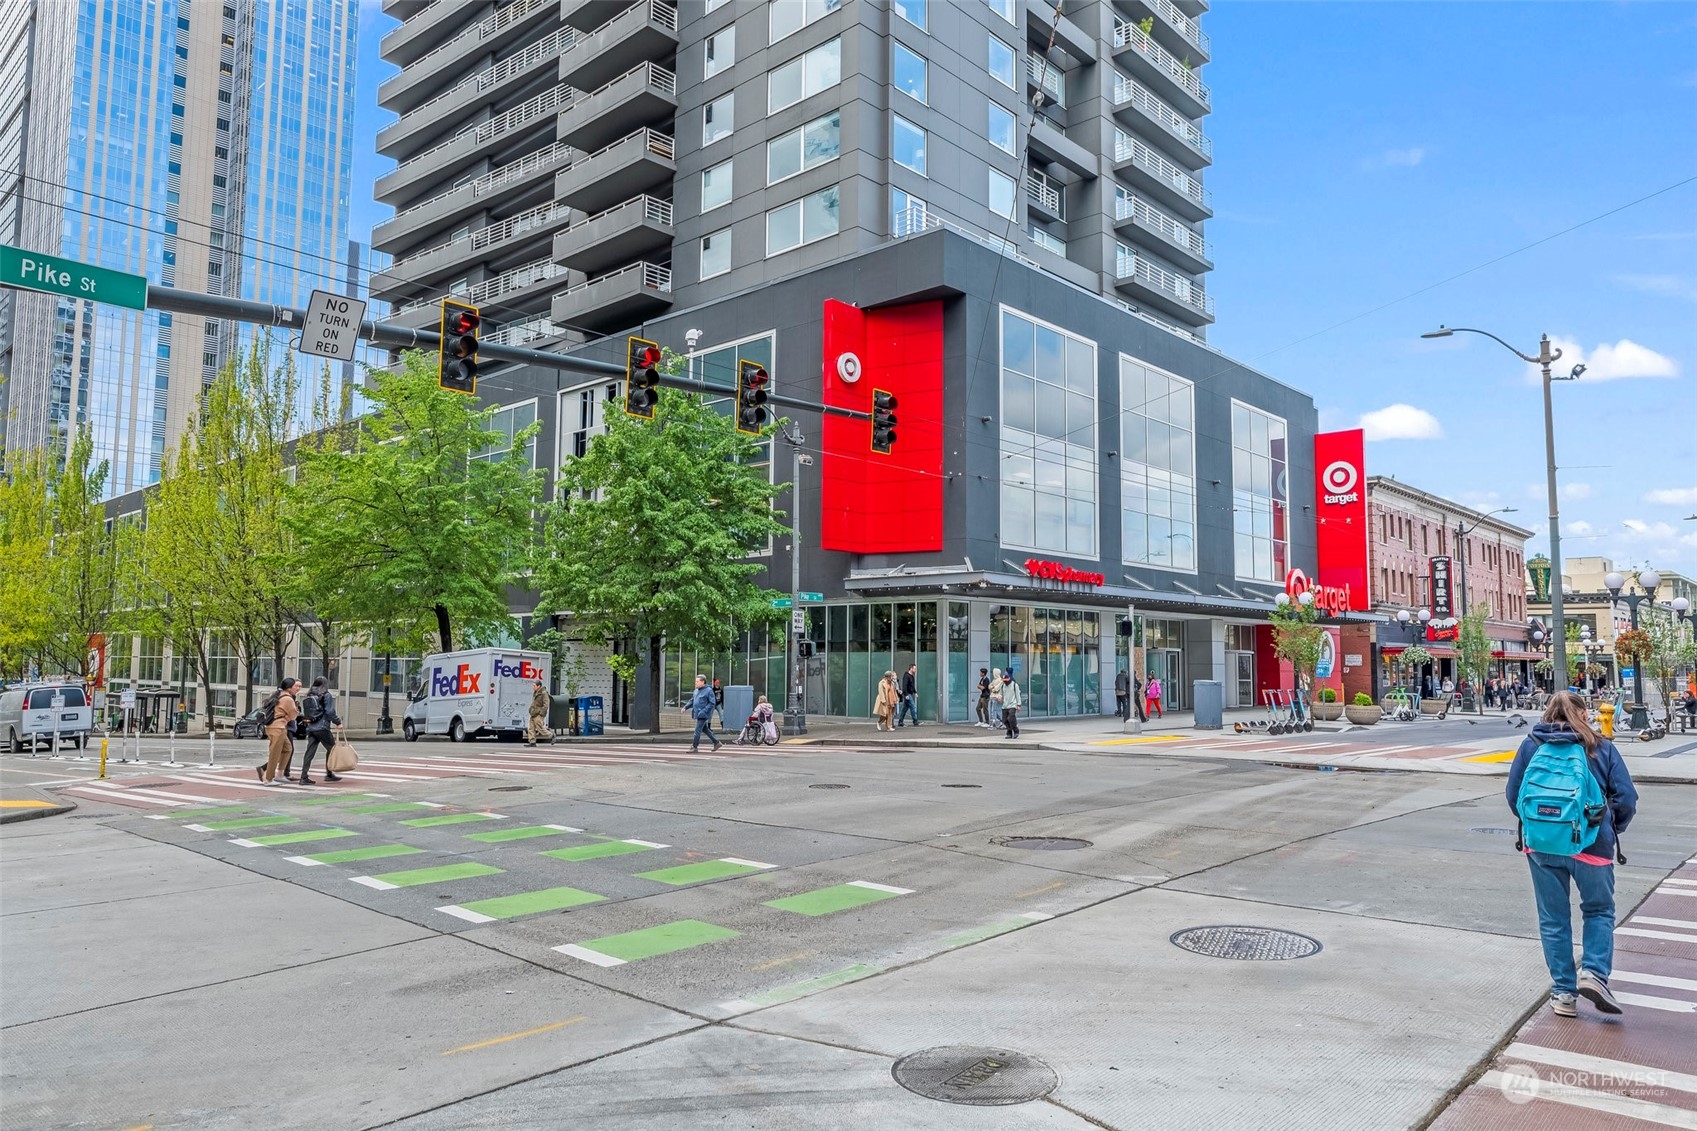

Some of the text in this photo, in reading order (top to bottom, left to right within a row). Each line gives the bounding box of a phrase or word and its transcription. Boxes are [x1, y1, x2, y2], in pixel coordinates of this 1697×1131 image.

[21, 258, 96, 293] Pike St
[326, 298, 349, 313] NO
[320, 312, 350, 328] TURN
[323, 328, 339, 340] ON
[315, 341, 339, 354] RED
[1324, 492, 1358, 505] target
[1435, 562, 1447, 605] SHIRT
[494, 659, 543, 680] FedEx
[432, 664, 481, 697] FedEx
